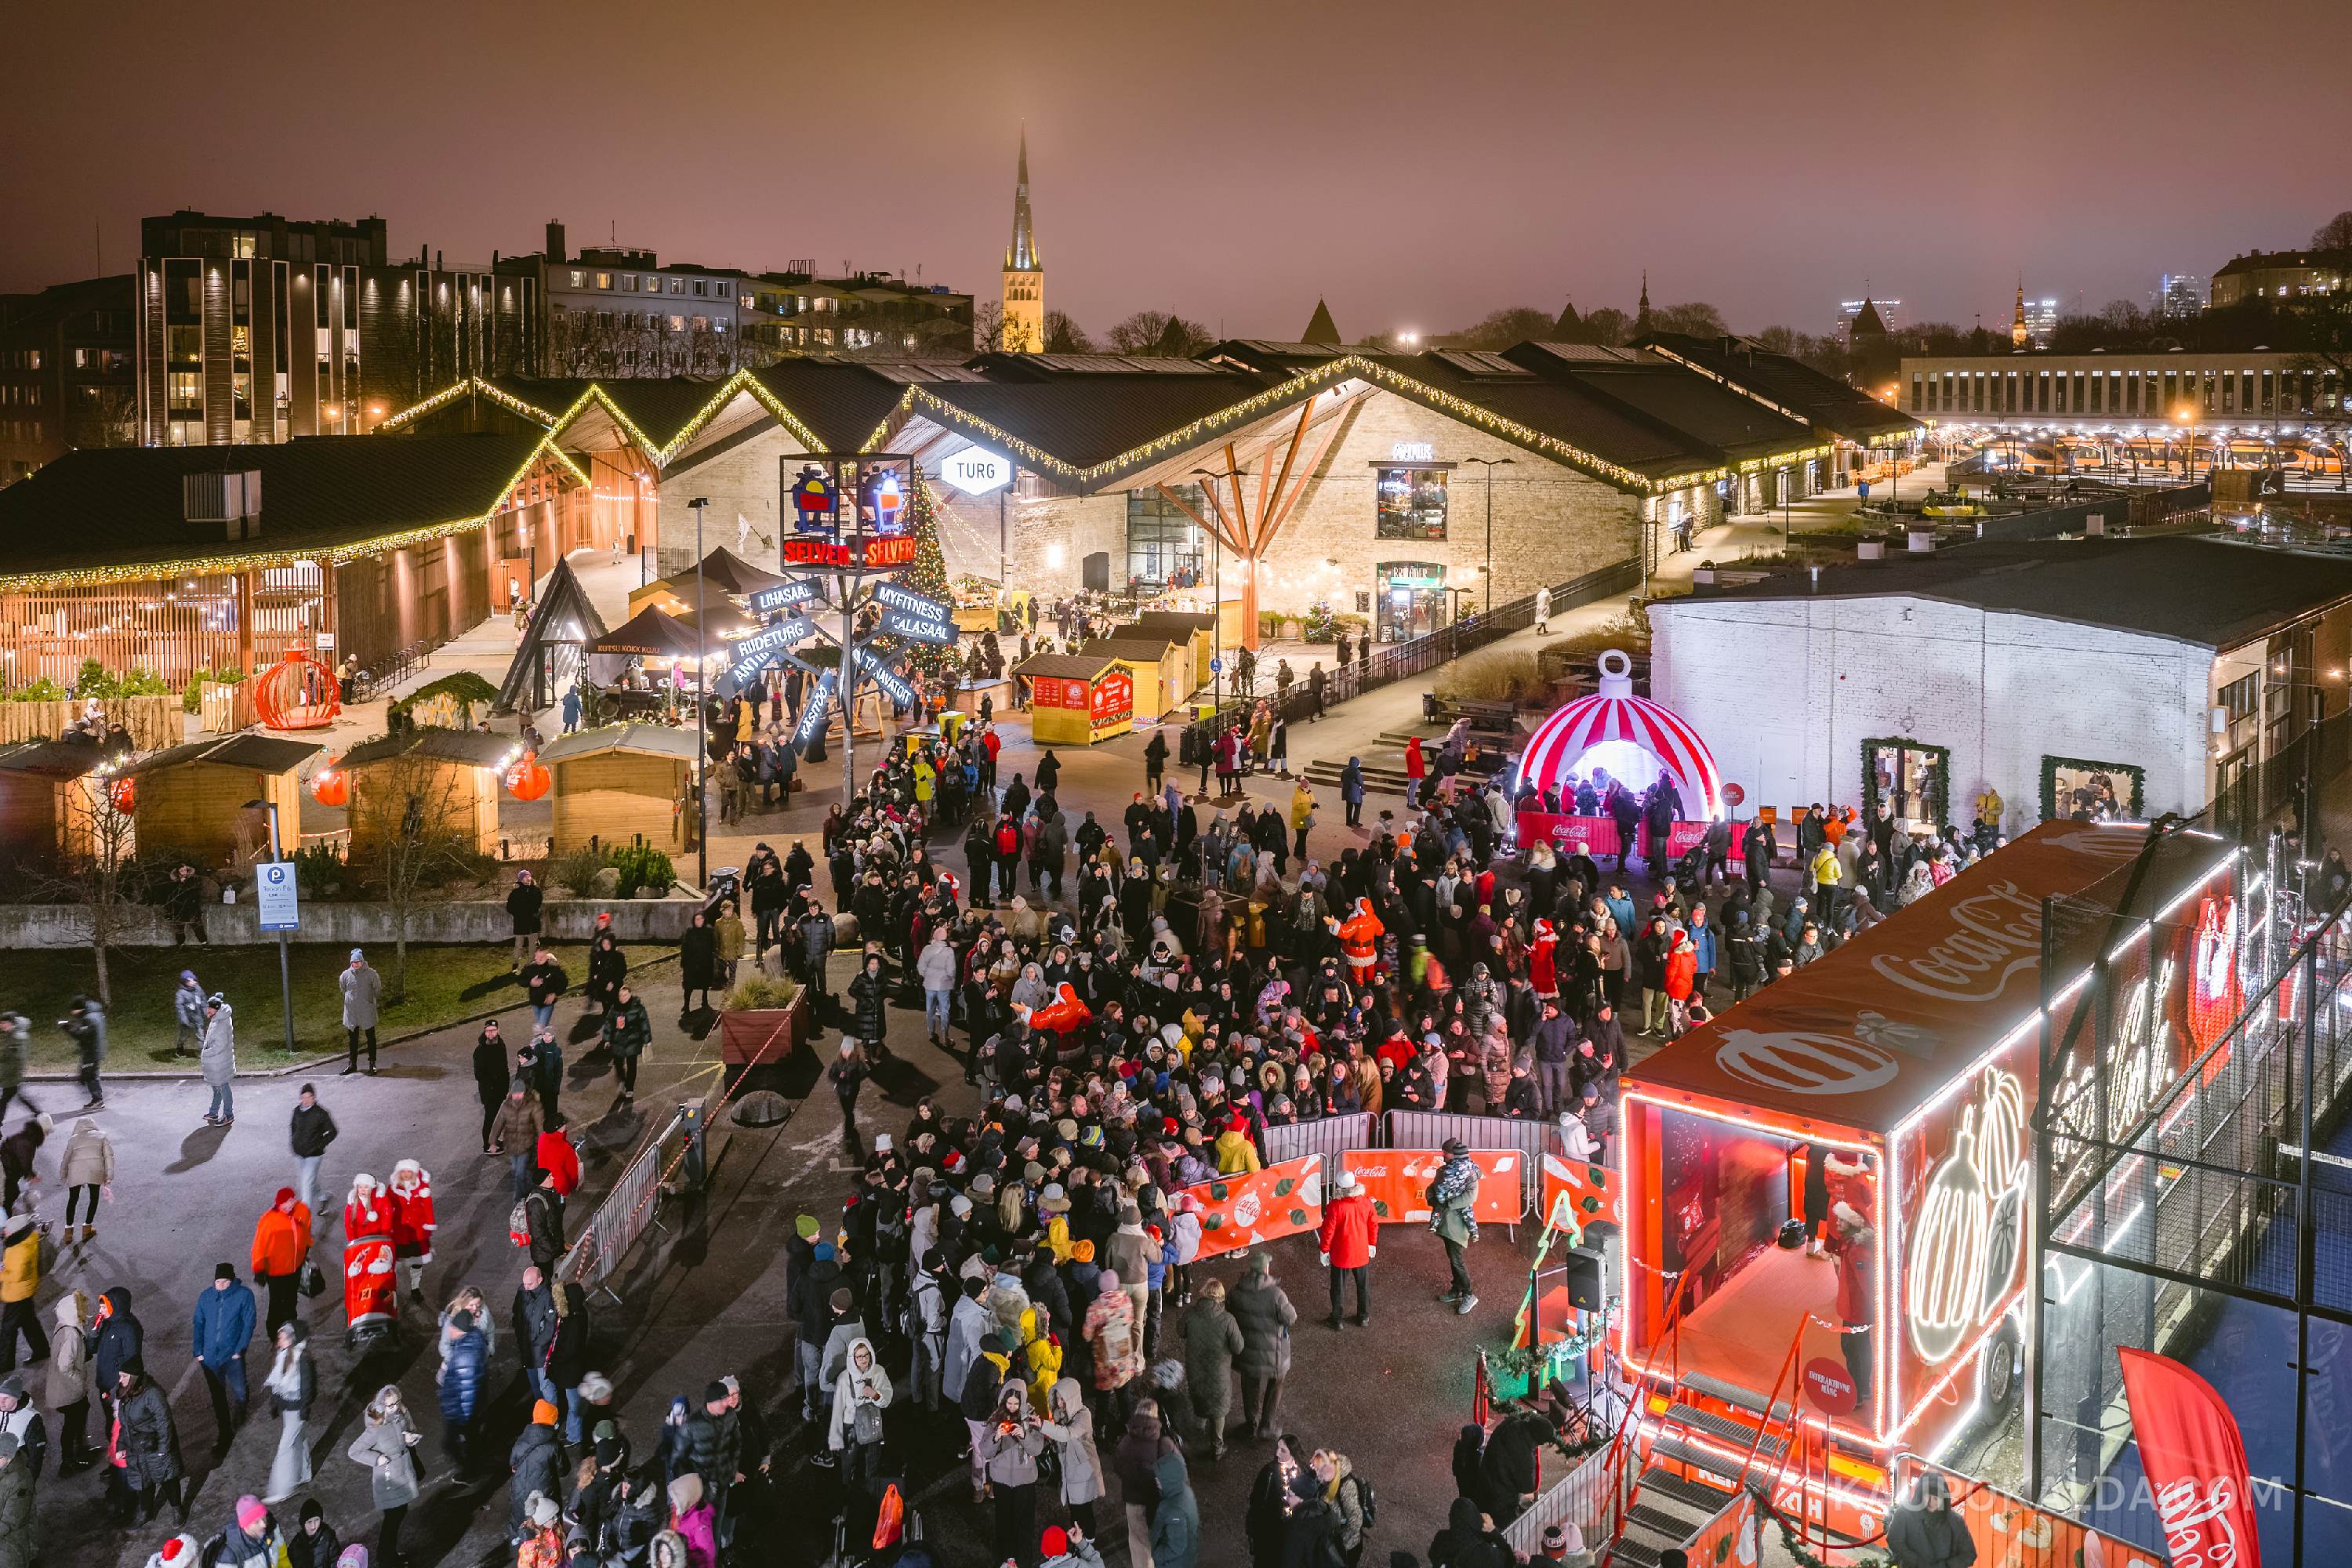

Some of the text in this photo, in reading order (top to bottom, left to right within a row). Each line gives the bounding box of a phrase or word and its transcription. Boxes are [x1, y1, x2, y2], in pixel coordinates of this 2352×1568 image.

[956, 463, 995, 479] TURG
[784, 540, 850, 565] SELVER
[866, 538, 914, 564] SELVER
[759, 583, 811, 608] LIHASAAL
[878, 586, 943, 622] MYFITNESS
[597, 644, 620, 653] KUTSU
[738, 622, 804, 657] RIIDETURG
[800, 684, 828, 739] KÄSITÖÖ
[1355, 1166, 1388, 1177] Coca-Cola
